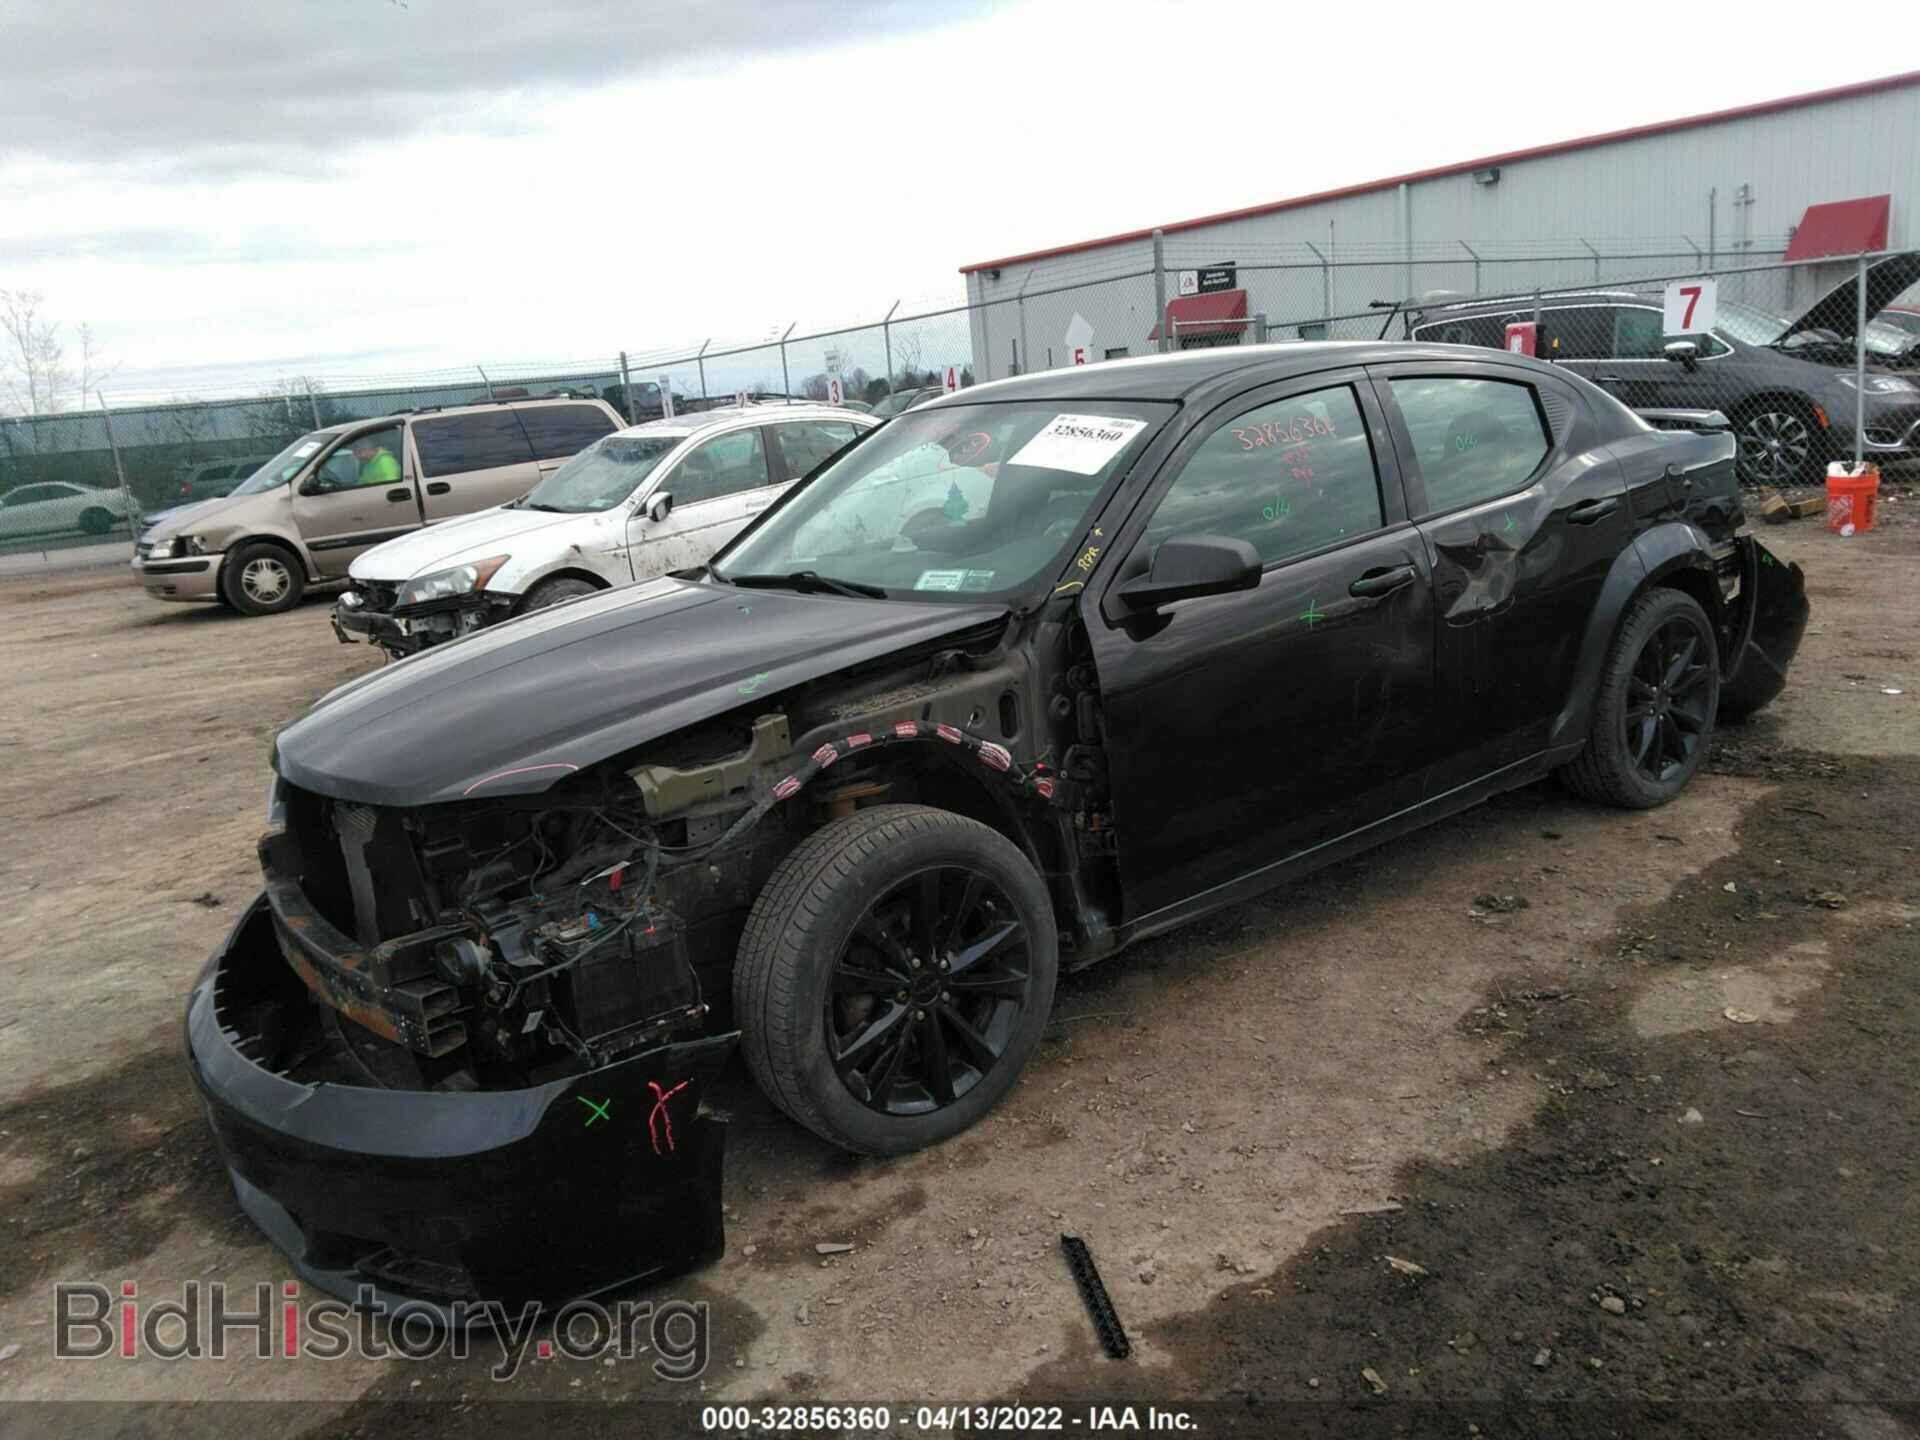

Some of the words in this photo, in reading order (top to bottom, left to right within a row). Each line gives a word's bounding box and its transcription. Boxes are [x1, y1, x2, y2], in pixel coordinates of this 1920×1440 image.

[1679, 286, 1703, 330] 7
[830, 379, 840, 404] 3
[946, 366, 956, 393] 4
[1052, 424, 1124, 441] 32856360
